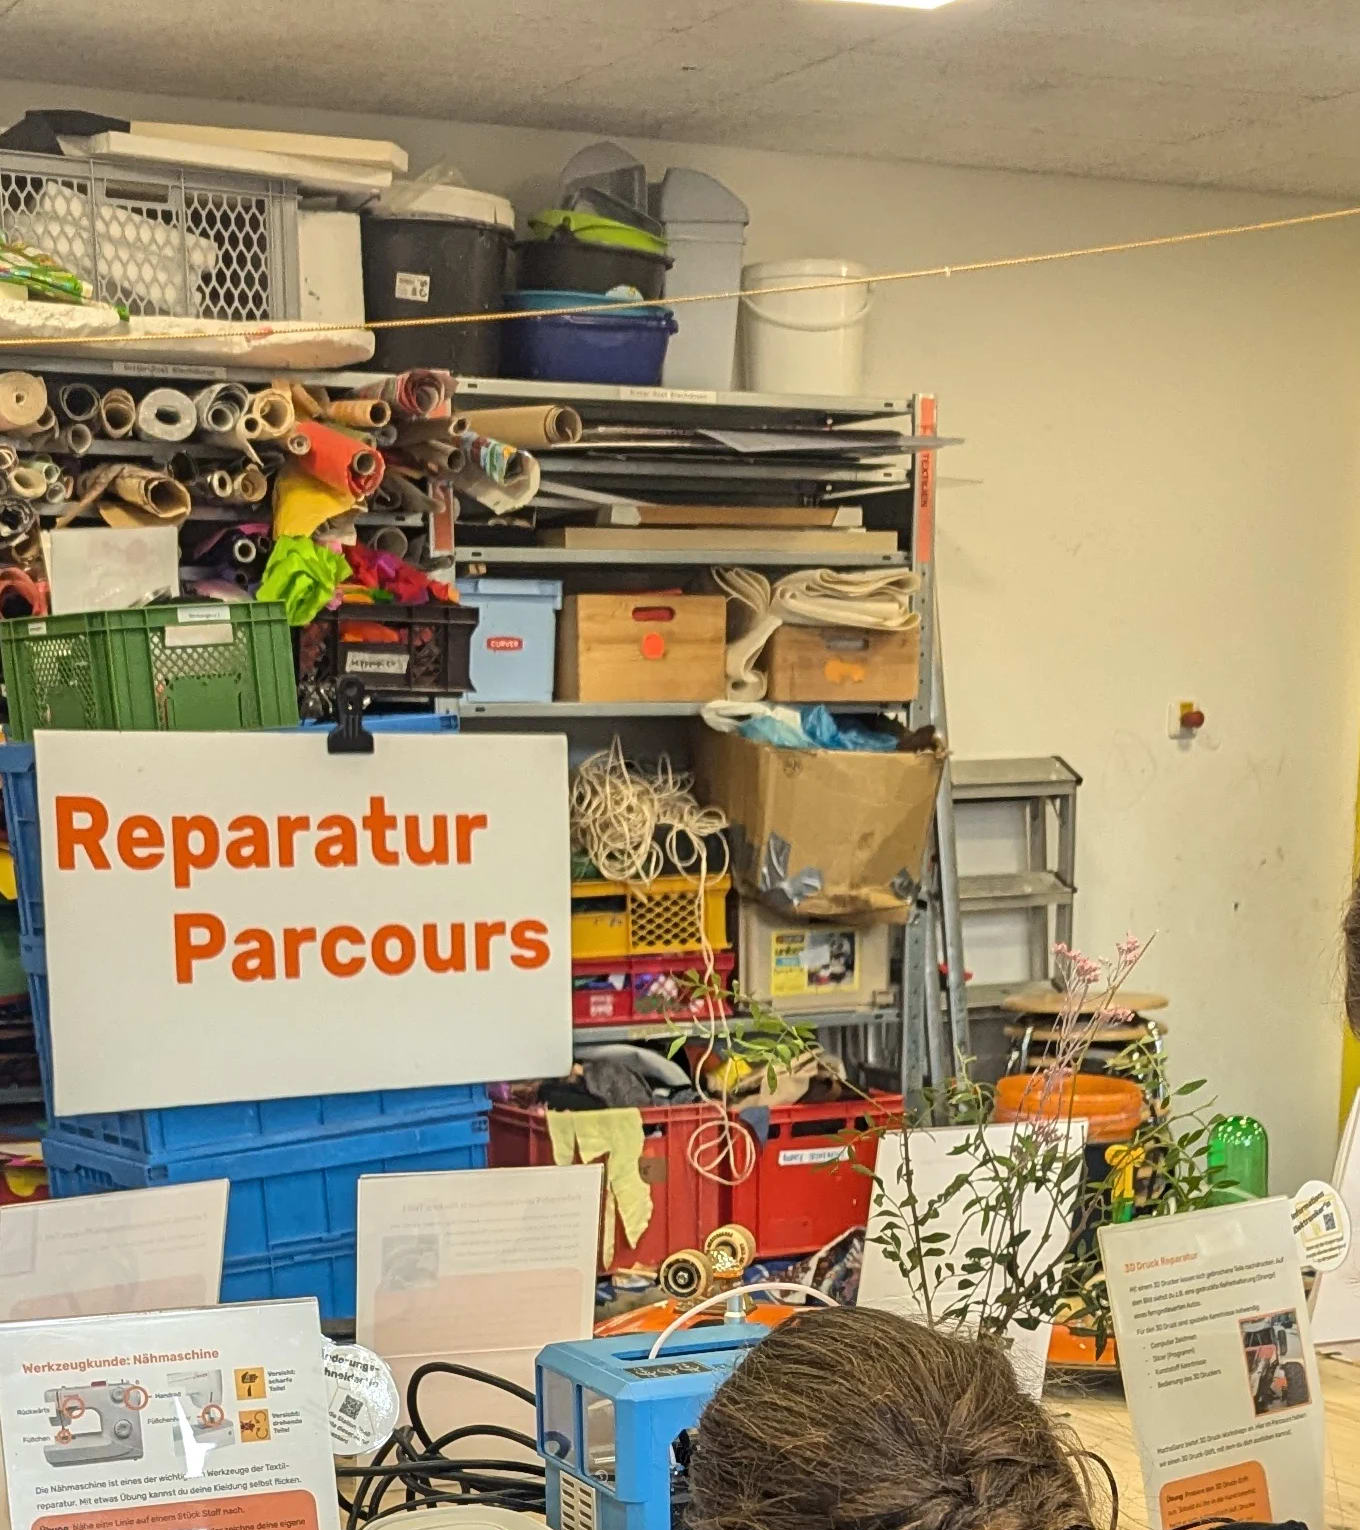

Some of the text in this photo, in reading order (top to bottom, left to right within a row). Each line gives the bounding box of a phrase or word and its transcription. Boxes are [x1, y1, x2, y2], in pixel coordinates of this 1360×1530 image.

[55, 795, 488, 888] Reparatur
[174, 913, 551, 984] Parcours
[22, 1349, 219, 1375] Werkzeugkunde: Nähmaschine
[36, 1462, 290, 1495] Die Nähmaschine ist eines der Werkzeuge der Textil-
[36, 1500, 78, 1511] reparatur.
[79, 1497, 93, 1506] Mit
[94, 1494, 118, 1505] etwas
[120, 1491, 147, 1502] Übung
[149, 1488, 176, 1498] kannst
[178, 1486, 188, 1495] du
[190, 1484, 212, 1494] deine
[214, 1480, 248, 1493] Kleidung
[249, 1478, 273, 1489] selbst
[115, 1517, 134, 1528] Linie
[136, 1514, 149, 1524] auf
[177, 1510, 200, 1520] Stück
[202, 1508, 221, 1518] Stoff
[256, 1520, 278, 1530] deine
[280, 1518, 306, 1528] eigene
